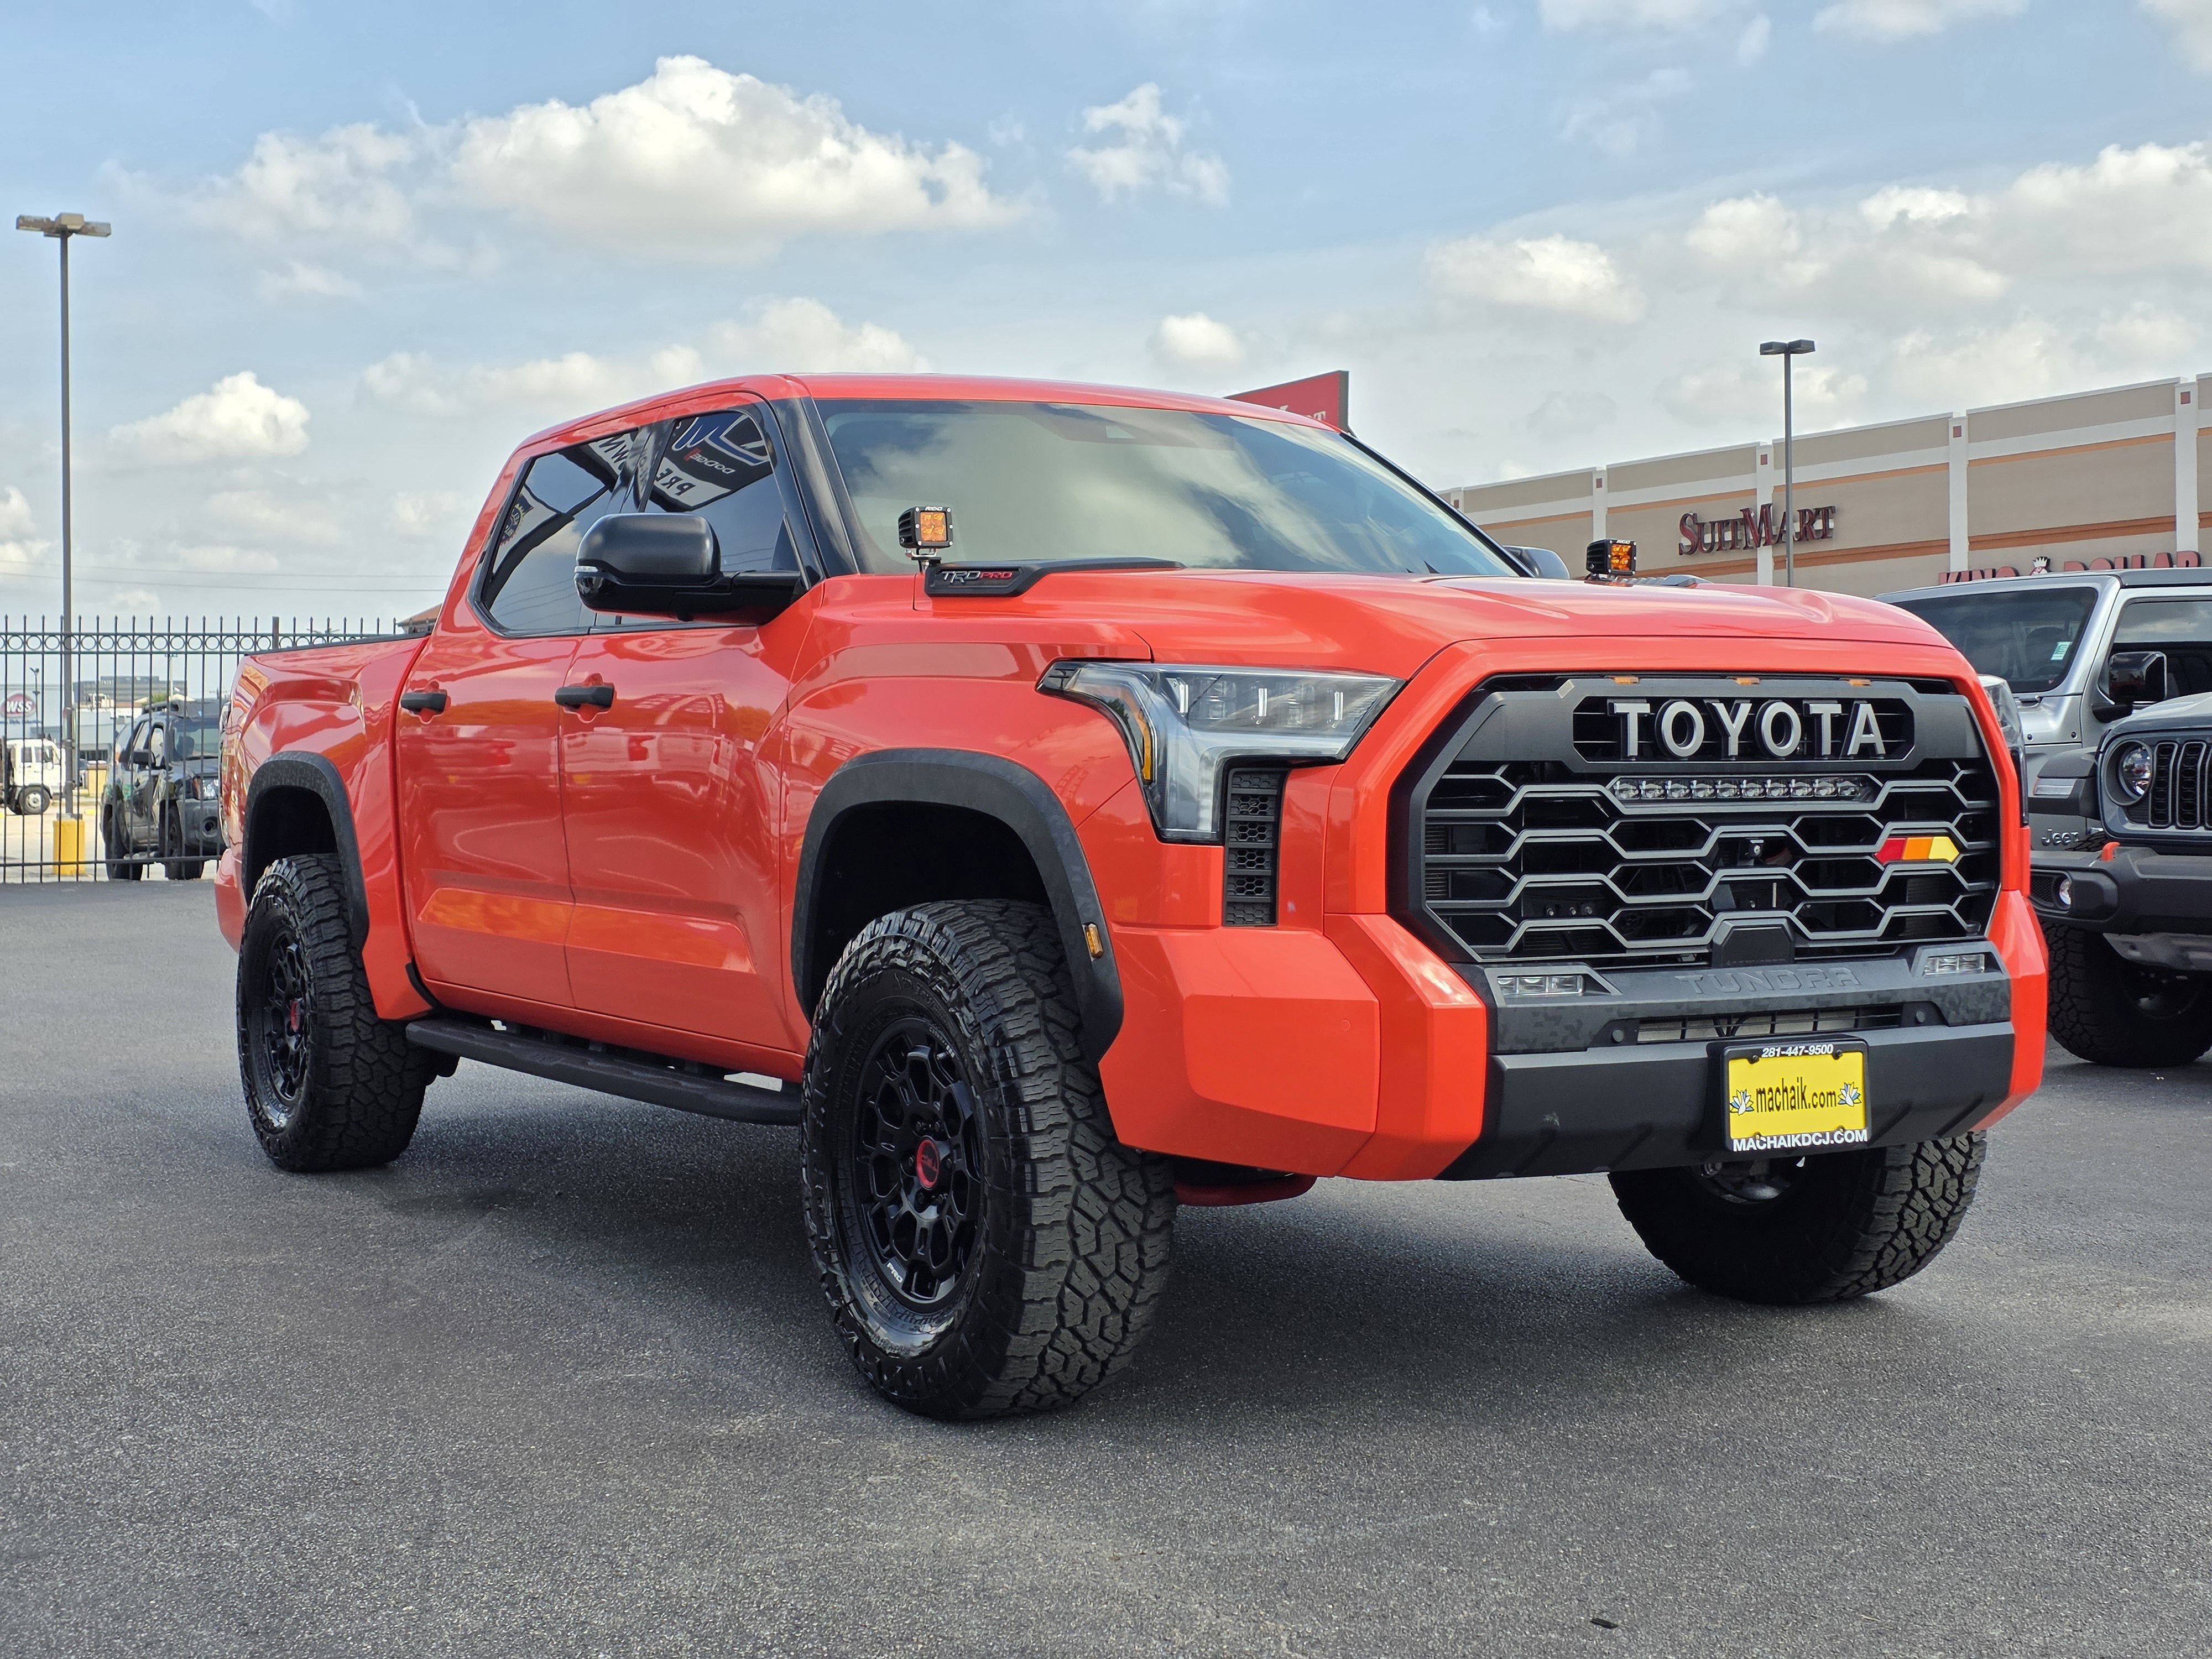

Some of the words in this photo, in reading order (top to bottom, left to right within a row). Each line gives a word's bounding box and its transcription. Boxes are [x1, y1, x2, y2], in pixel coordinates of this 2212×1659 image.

[942, 571, 981, 583] TRD
[6, 700, 33, 713] WSS
[1614, 701, 1886, 757] TOYOTA
[1674, 968, 1861, 994] TUNDRA
[1761, 1044, 1834, 1057] 281-447-9500
[1756, 1077, 1837, 1113] machaik.com
[1733, 1129, 1868, 1152] MACHAIKDCJ.COM
[886, 1262, 903, 1284] PRO
